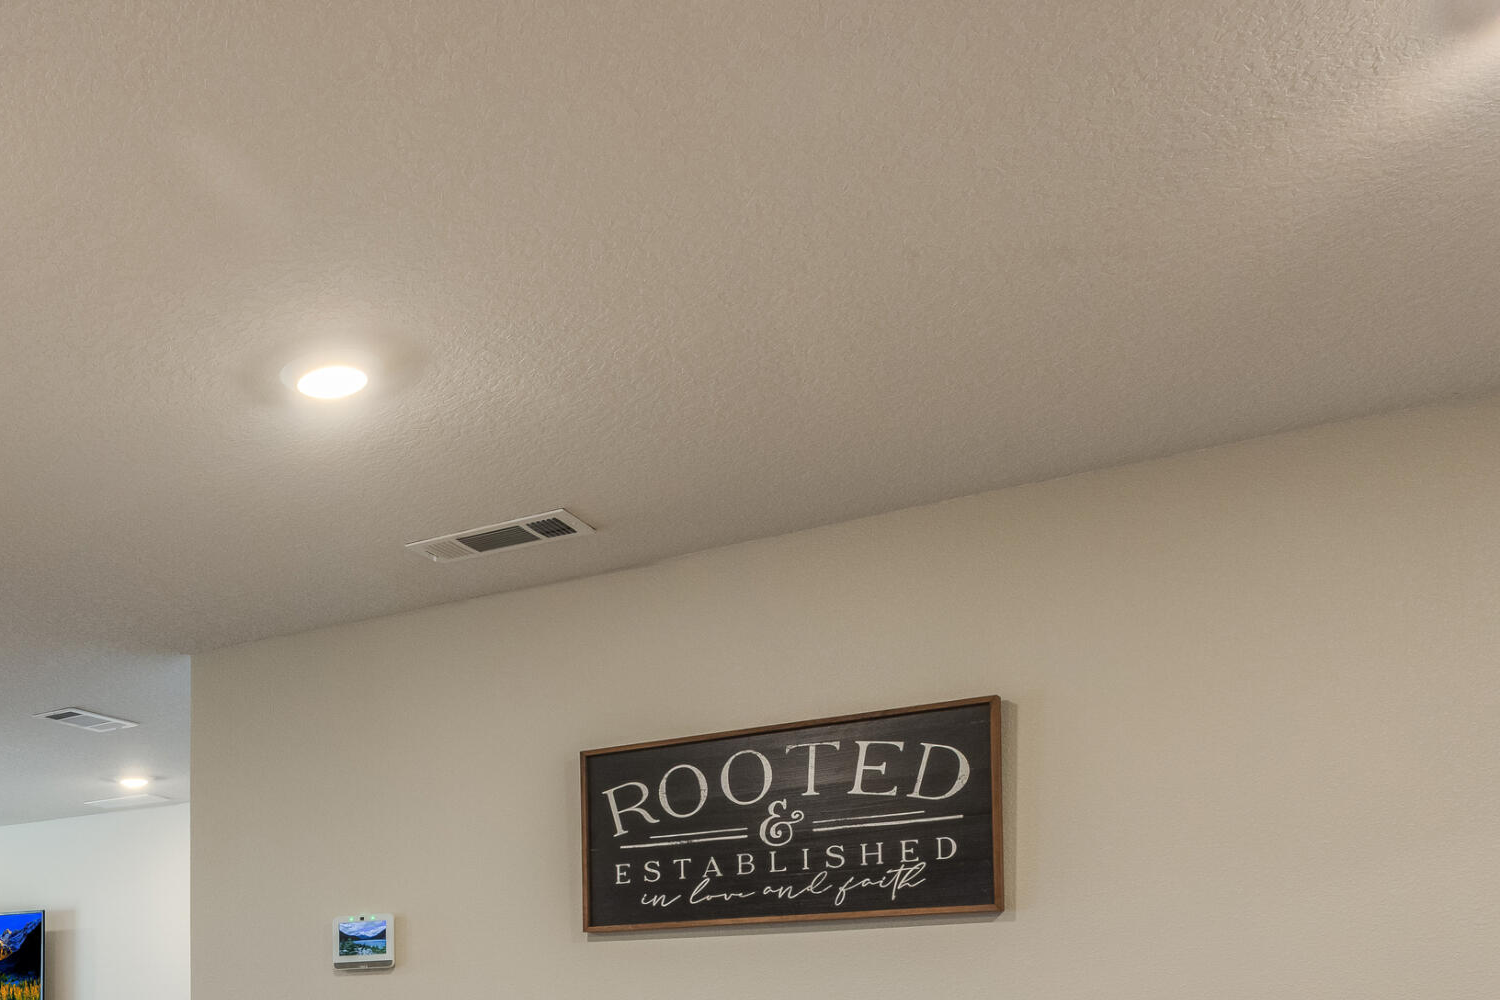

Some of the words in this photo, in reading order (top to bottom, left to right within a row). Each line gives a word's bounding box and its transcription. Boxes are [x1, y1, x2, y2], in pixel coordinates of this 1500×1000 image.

[601, 740, 971, 837] ROOTED
[759, 798, 805, 847] &
[615, 836, 957, 886] ESTABLISHED
[640, 892, 682, 907] in
[689, 877, 756, 905] love
[762, 870, 833, 899] and
[834, 861, 927, 906] faith
